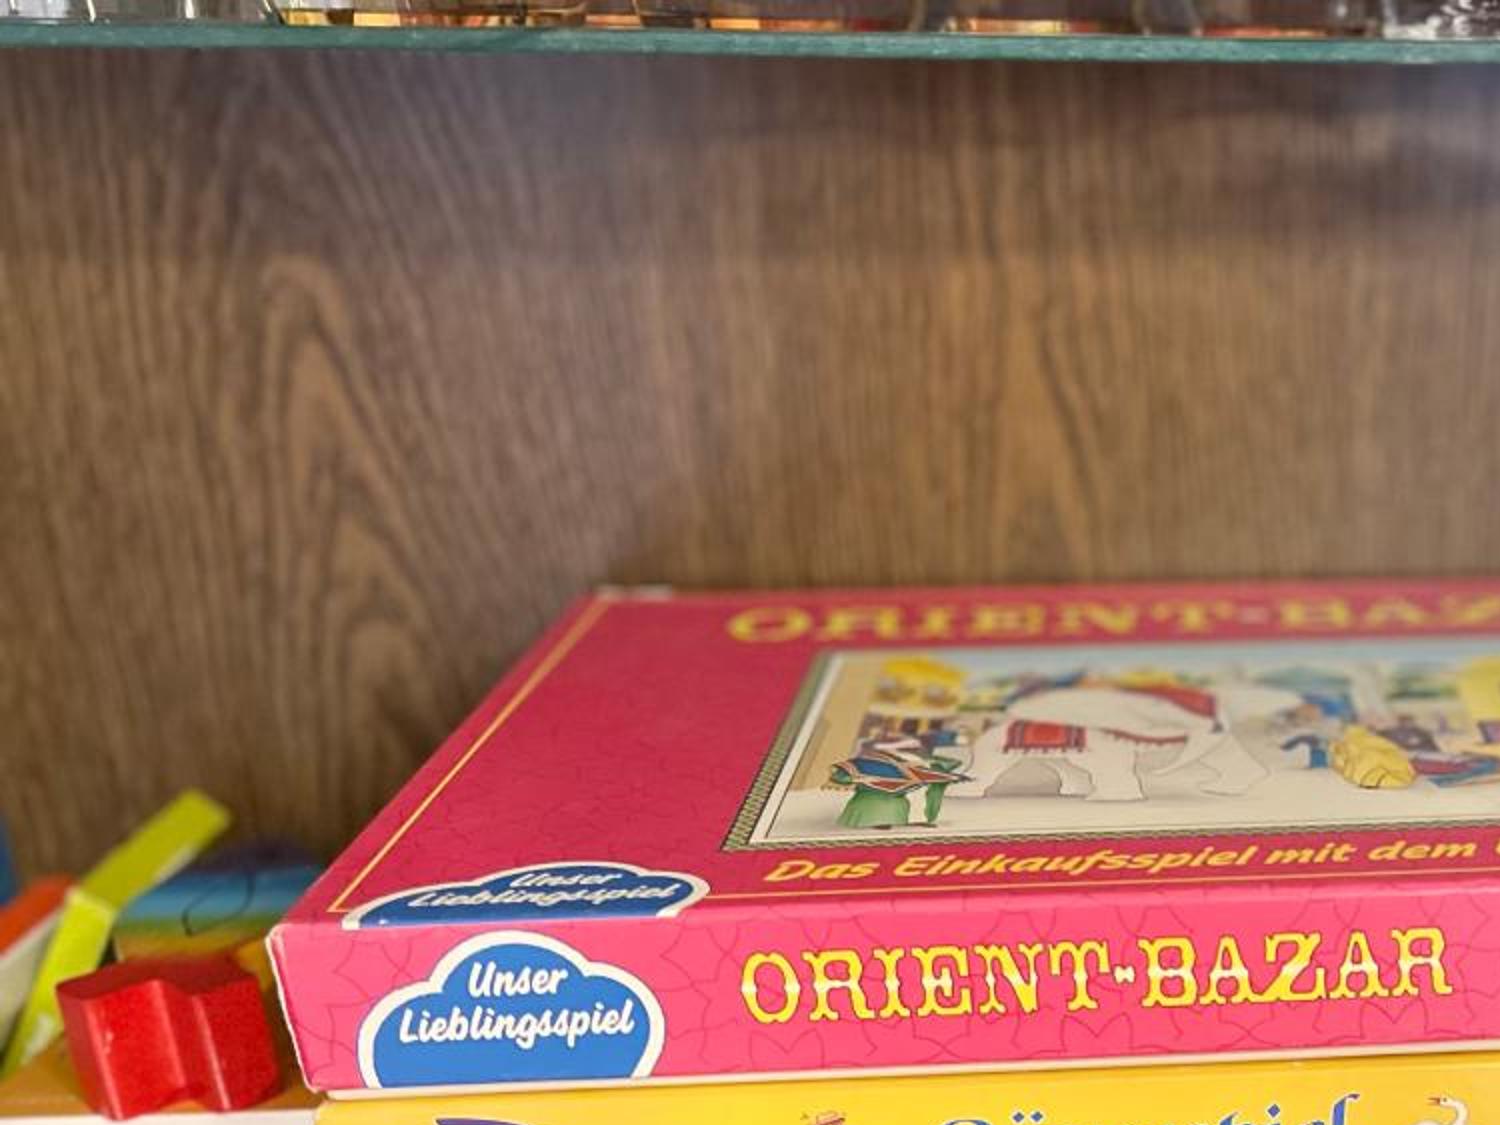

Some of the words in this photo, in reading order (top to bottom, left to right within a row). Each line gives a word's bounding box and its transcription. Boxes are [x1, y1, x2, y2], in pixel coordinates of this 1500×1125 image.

[764, 859, 881, 883] Das
[893, 845, 1258, 877] Einkaufsspiel
[1264, 842, 1357, 865] mit
[1368, 840, 1477, 862] dem
[467, 961, 569, 998] Unser
[738, 926, 1454, 1025] ORIENT-BAZAR
[399, 998, 635, 1049] Lieblingsspiel
